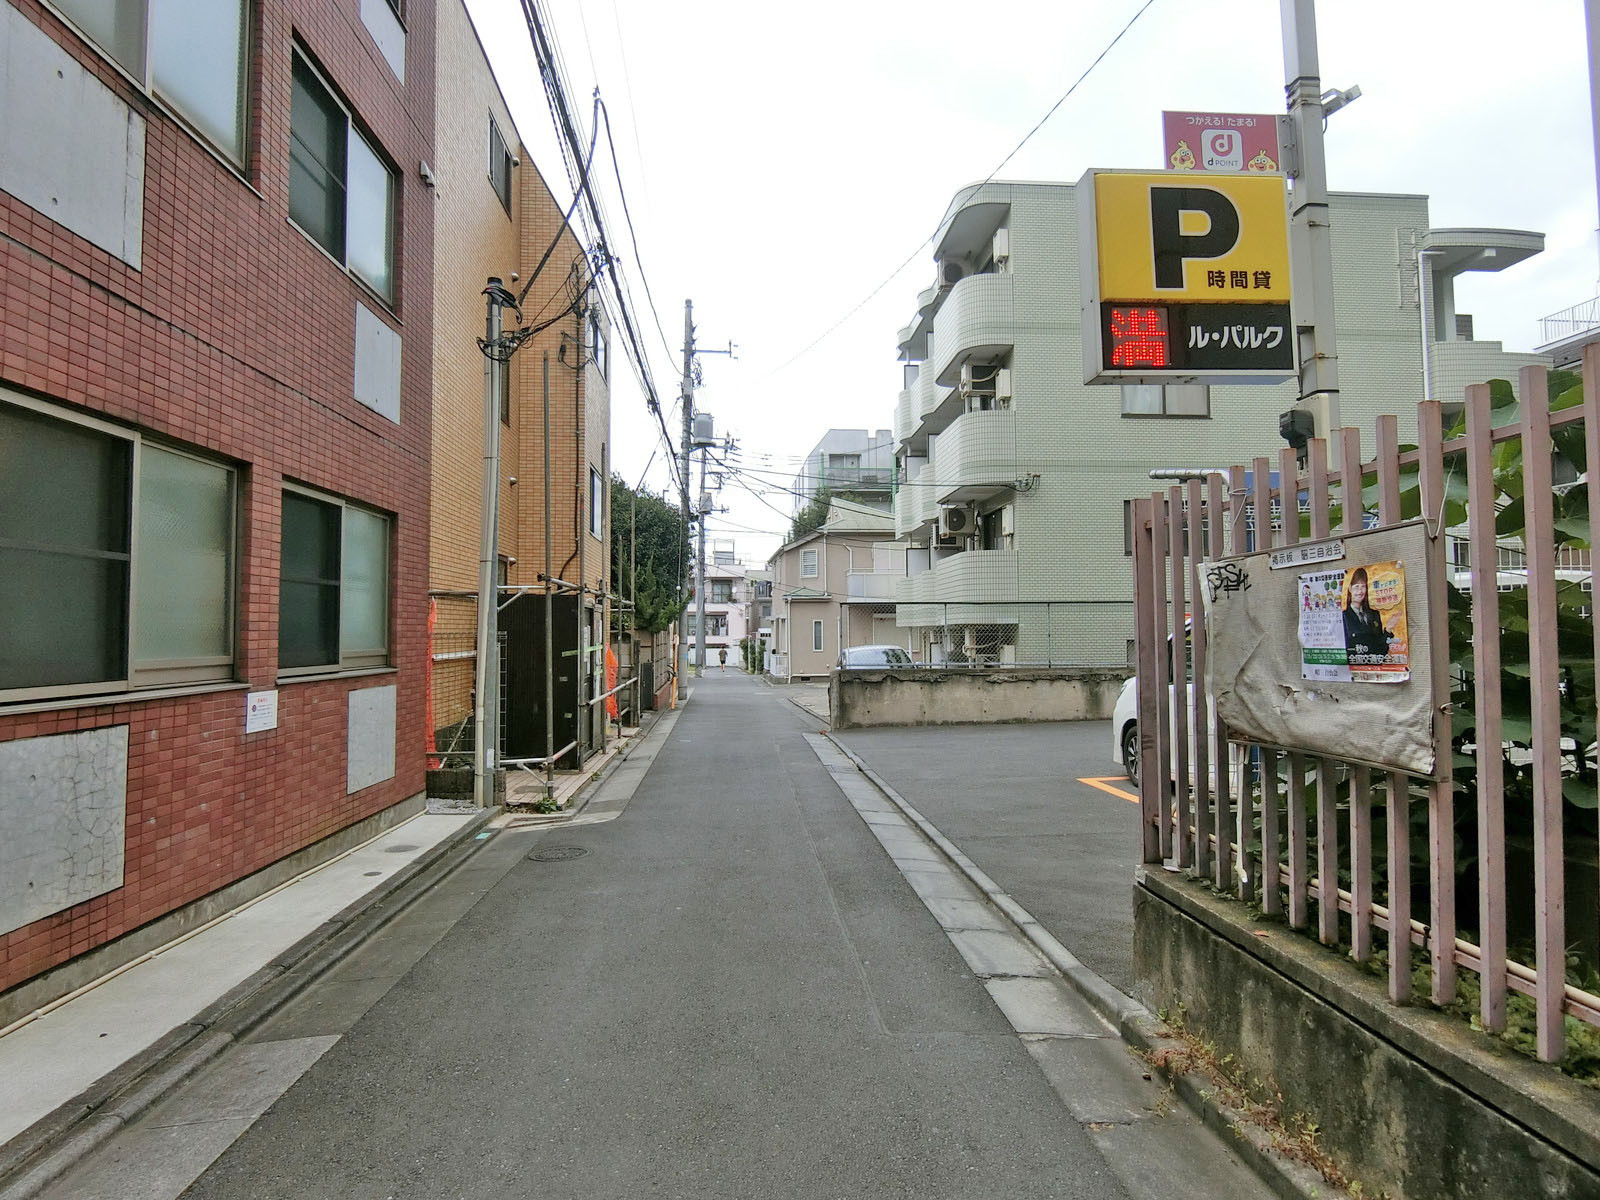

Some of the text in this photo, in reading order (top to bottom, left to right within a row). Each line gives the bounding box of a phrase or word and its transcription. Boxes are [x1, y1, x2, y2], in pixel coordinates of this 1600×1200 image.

[1185, 116, 1257, 127] つかえる! たまる!
[1207, 157, 1239, 167] d POINT
[1150, 186, 1240, 289] P
[1207, 270, 1272, 290] 時間貸
[1110, 309, 1167, 367] 満
[1187, 325, 1284, 350] ル・パルク
[1272, 551, 1294, 566] 掲示板
[1355, 643, 1369, 654] 秋の
[1348, 654, 1408, 664] 全国交通安全運動
